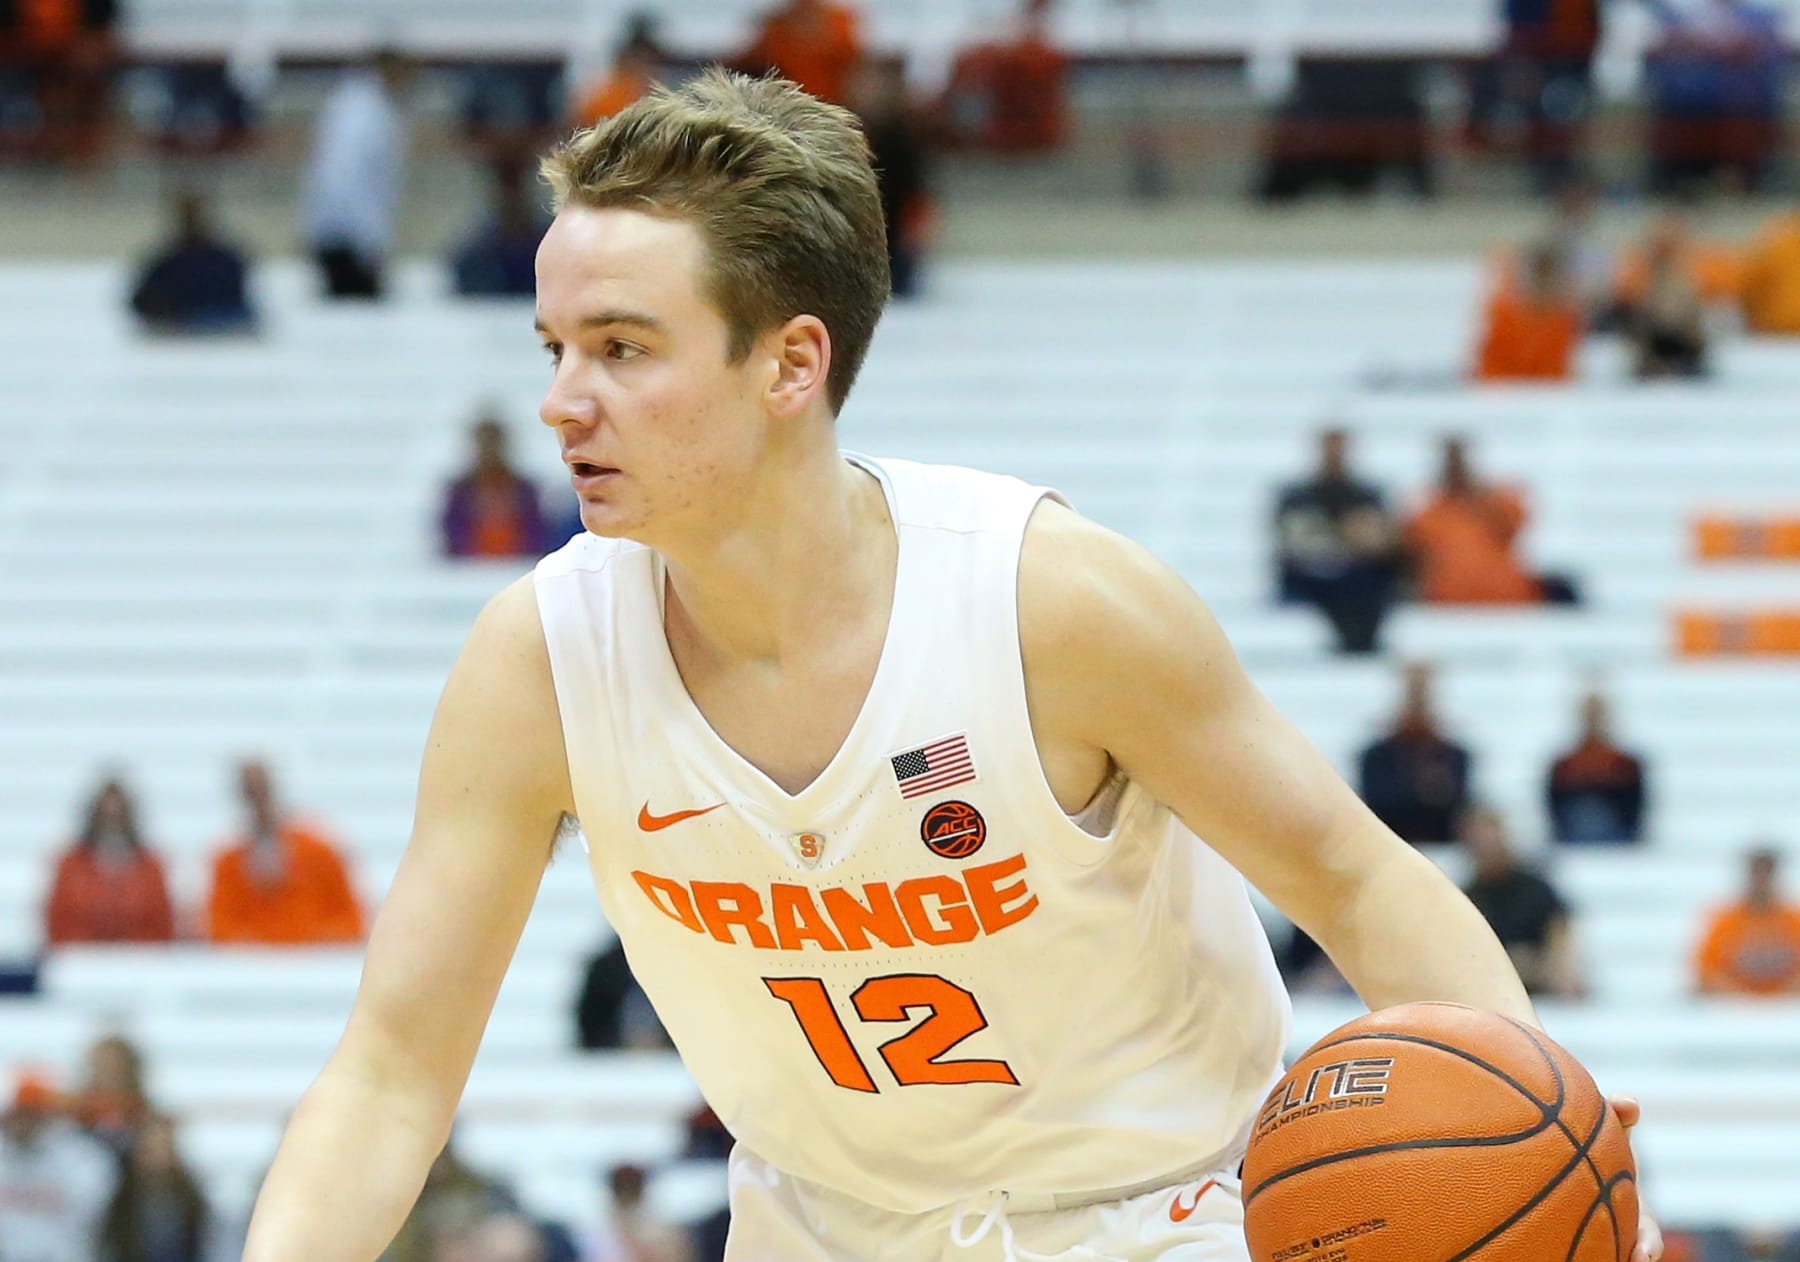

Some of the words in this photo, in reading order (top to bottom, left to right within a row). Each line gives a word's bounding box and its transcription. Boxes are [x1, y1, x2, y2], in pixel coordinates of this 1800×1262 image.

[800, 835, 817, 858] S
[933, 815, 977, 837] ACC
[631, 853, 1039, 952] ORANGE
[761, 973, 1021, 1094] 12
[1254, 1097, 1385, 1147] CHAMPIONSHIP
[1258, 1058, 1395, 1132] ELITE
